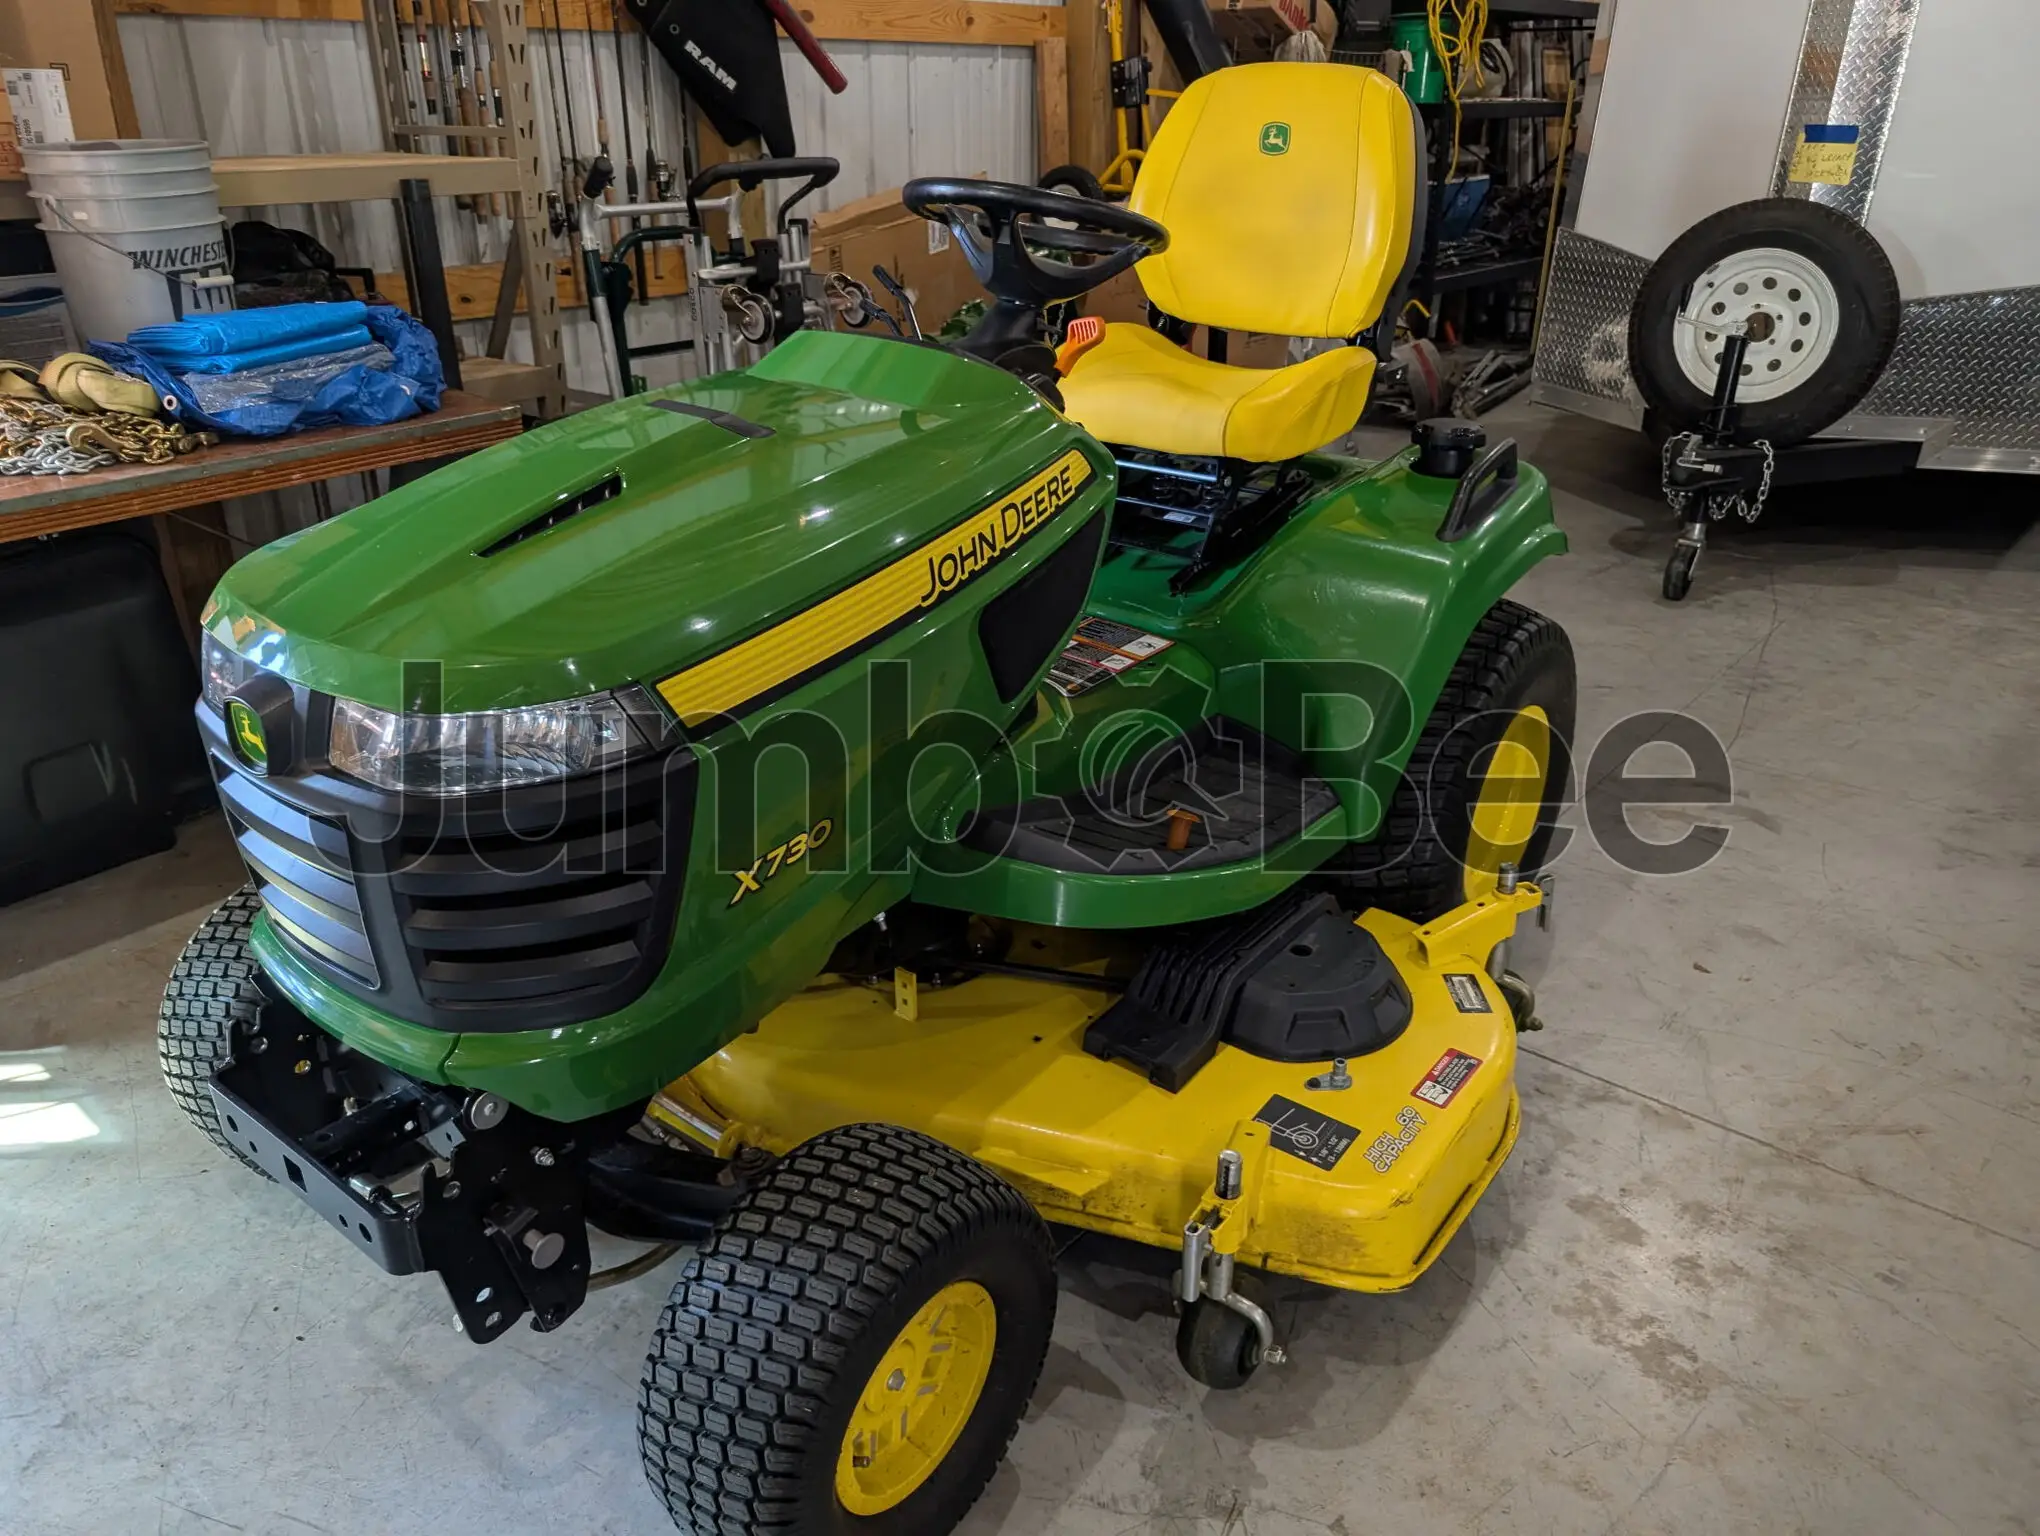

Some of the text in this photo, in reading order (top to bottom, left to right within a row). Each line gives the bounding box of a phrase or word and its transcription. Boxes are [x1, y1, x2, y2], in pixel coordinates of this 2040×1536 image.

[684, 40, 736, 90] RAM
[920, 465, 1074, 605] JOHN DEERE
[728, 818, 833, 907] X730
[1363, 1106, 1417, 1163] HIGH 60
[1374, 1112, 1427, 1173] CAPACITY
